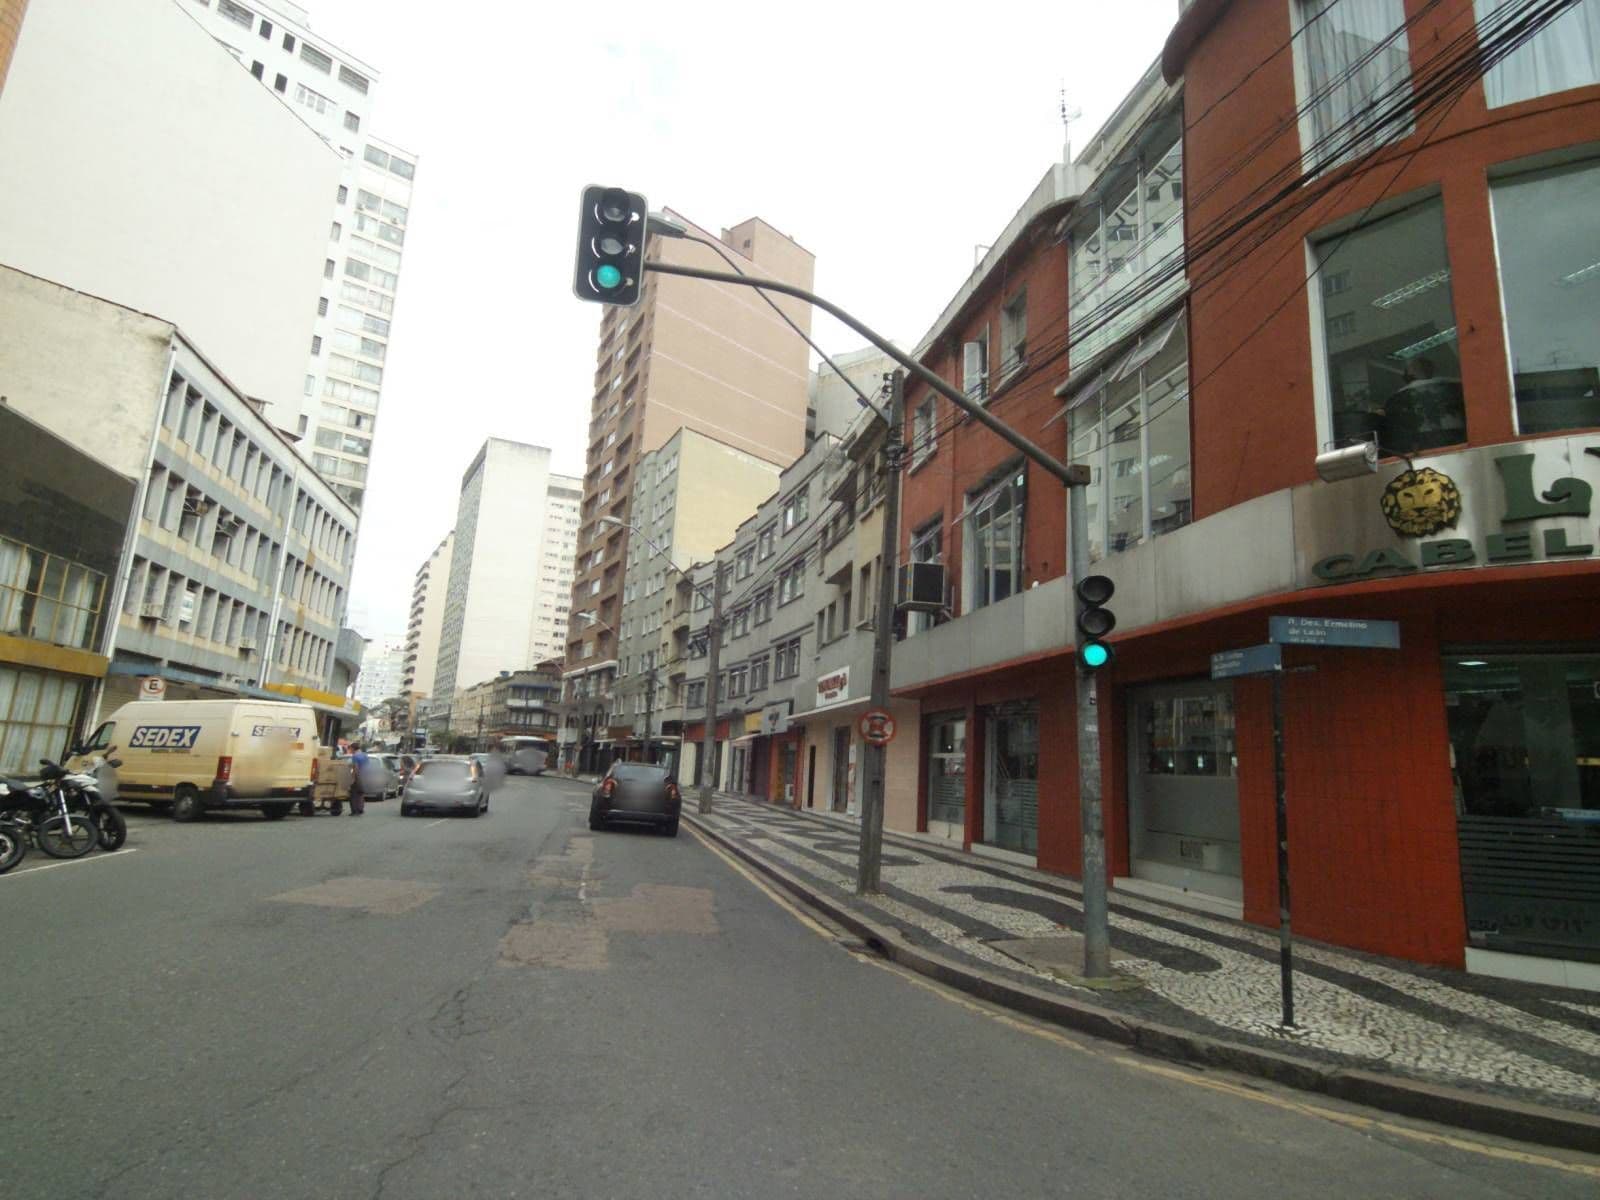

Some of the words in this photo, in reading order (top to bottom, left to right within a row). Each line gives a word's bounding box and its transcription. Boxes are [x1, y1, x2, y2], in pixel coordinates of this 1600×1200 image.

[1494, 446, 1600, 524] L
[1311, 526, 1600, 580] CABEL
[149, 679, 159, 690] E
[132, 727, 197, 747] SEDEX
[253, 726, 300, 738] SEX
